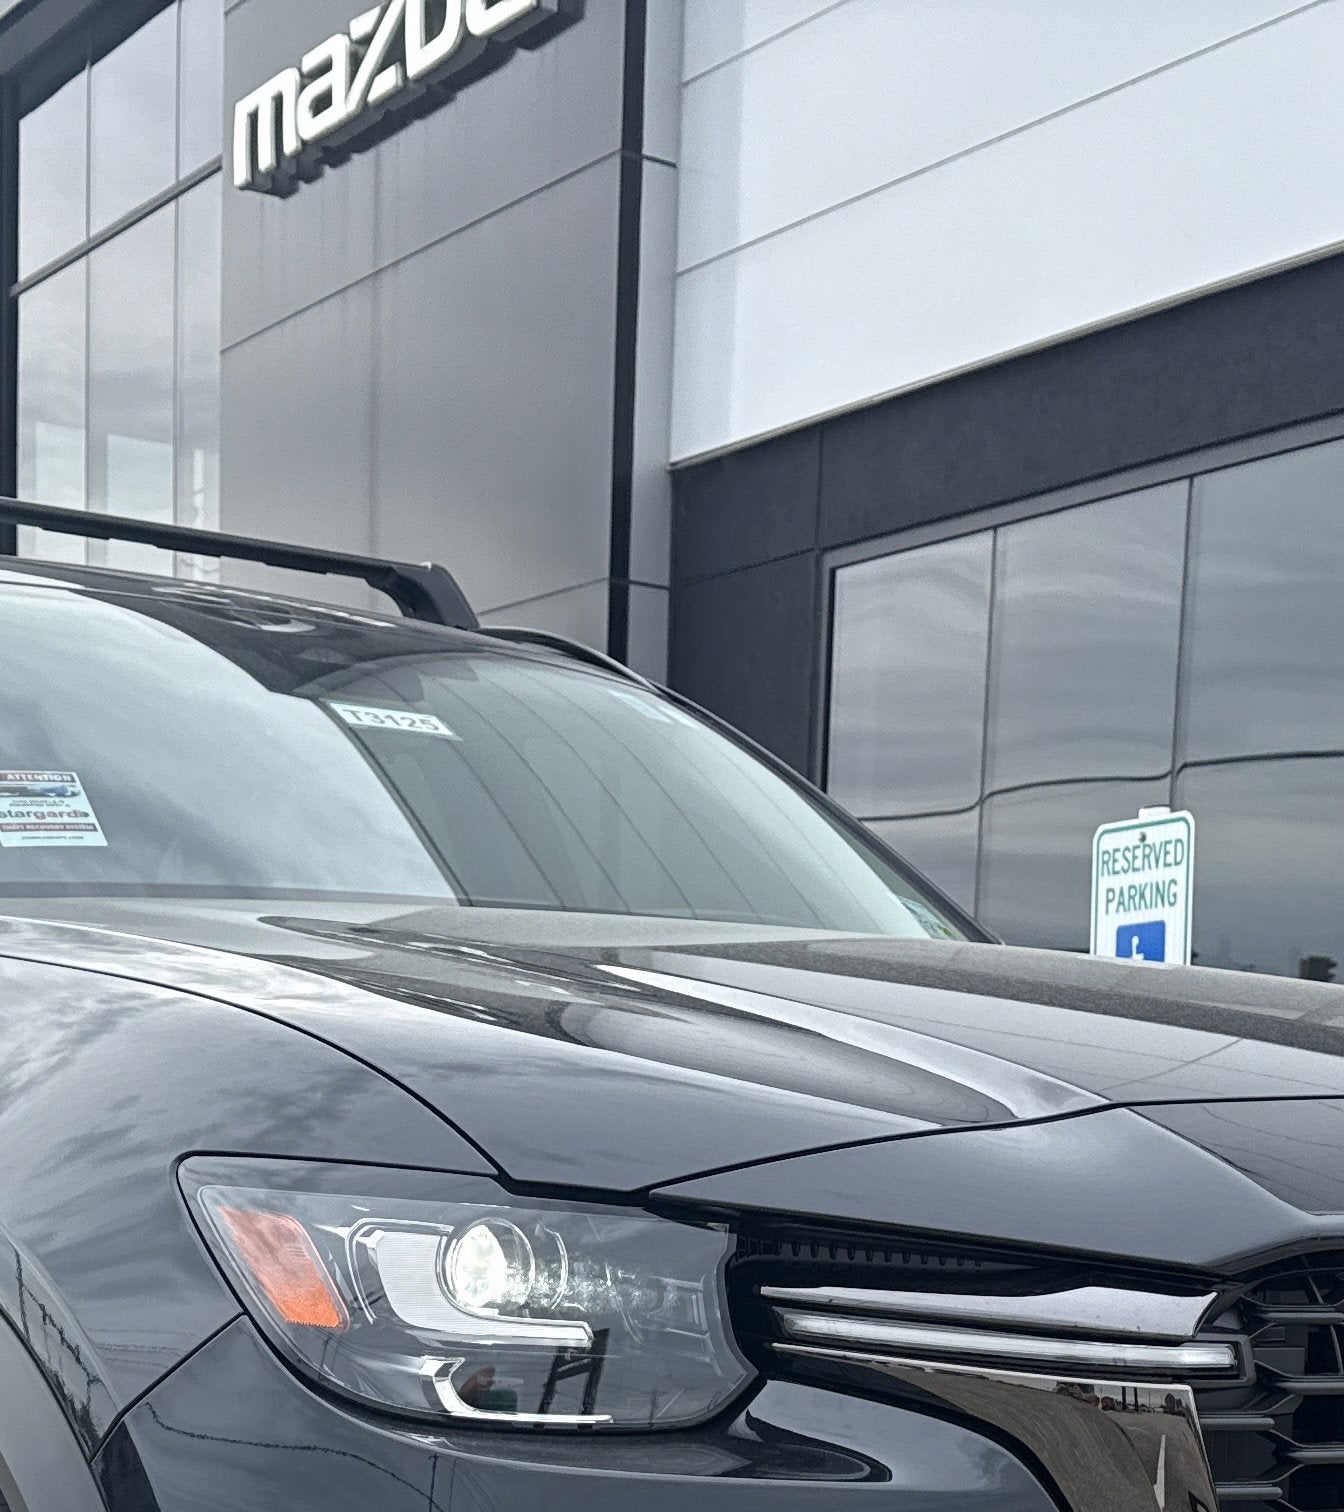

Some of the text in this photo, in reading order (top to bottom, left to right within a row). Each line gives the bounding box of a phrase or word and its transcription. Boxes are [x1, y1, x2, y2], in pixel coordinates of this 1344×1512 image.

[342, 708, 440, 732] T3125
[6, 773, 72, 782] ATTENTION
[1100, 838, 1185, 877] RESERVED
[1105, 878, 1178, 915] PARKING
